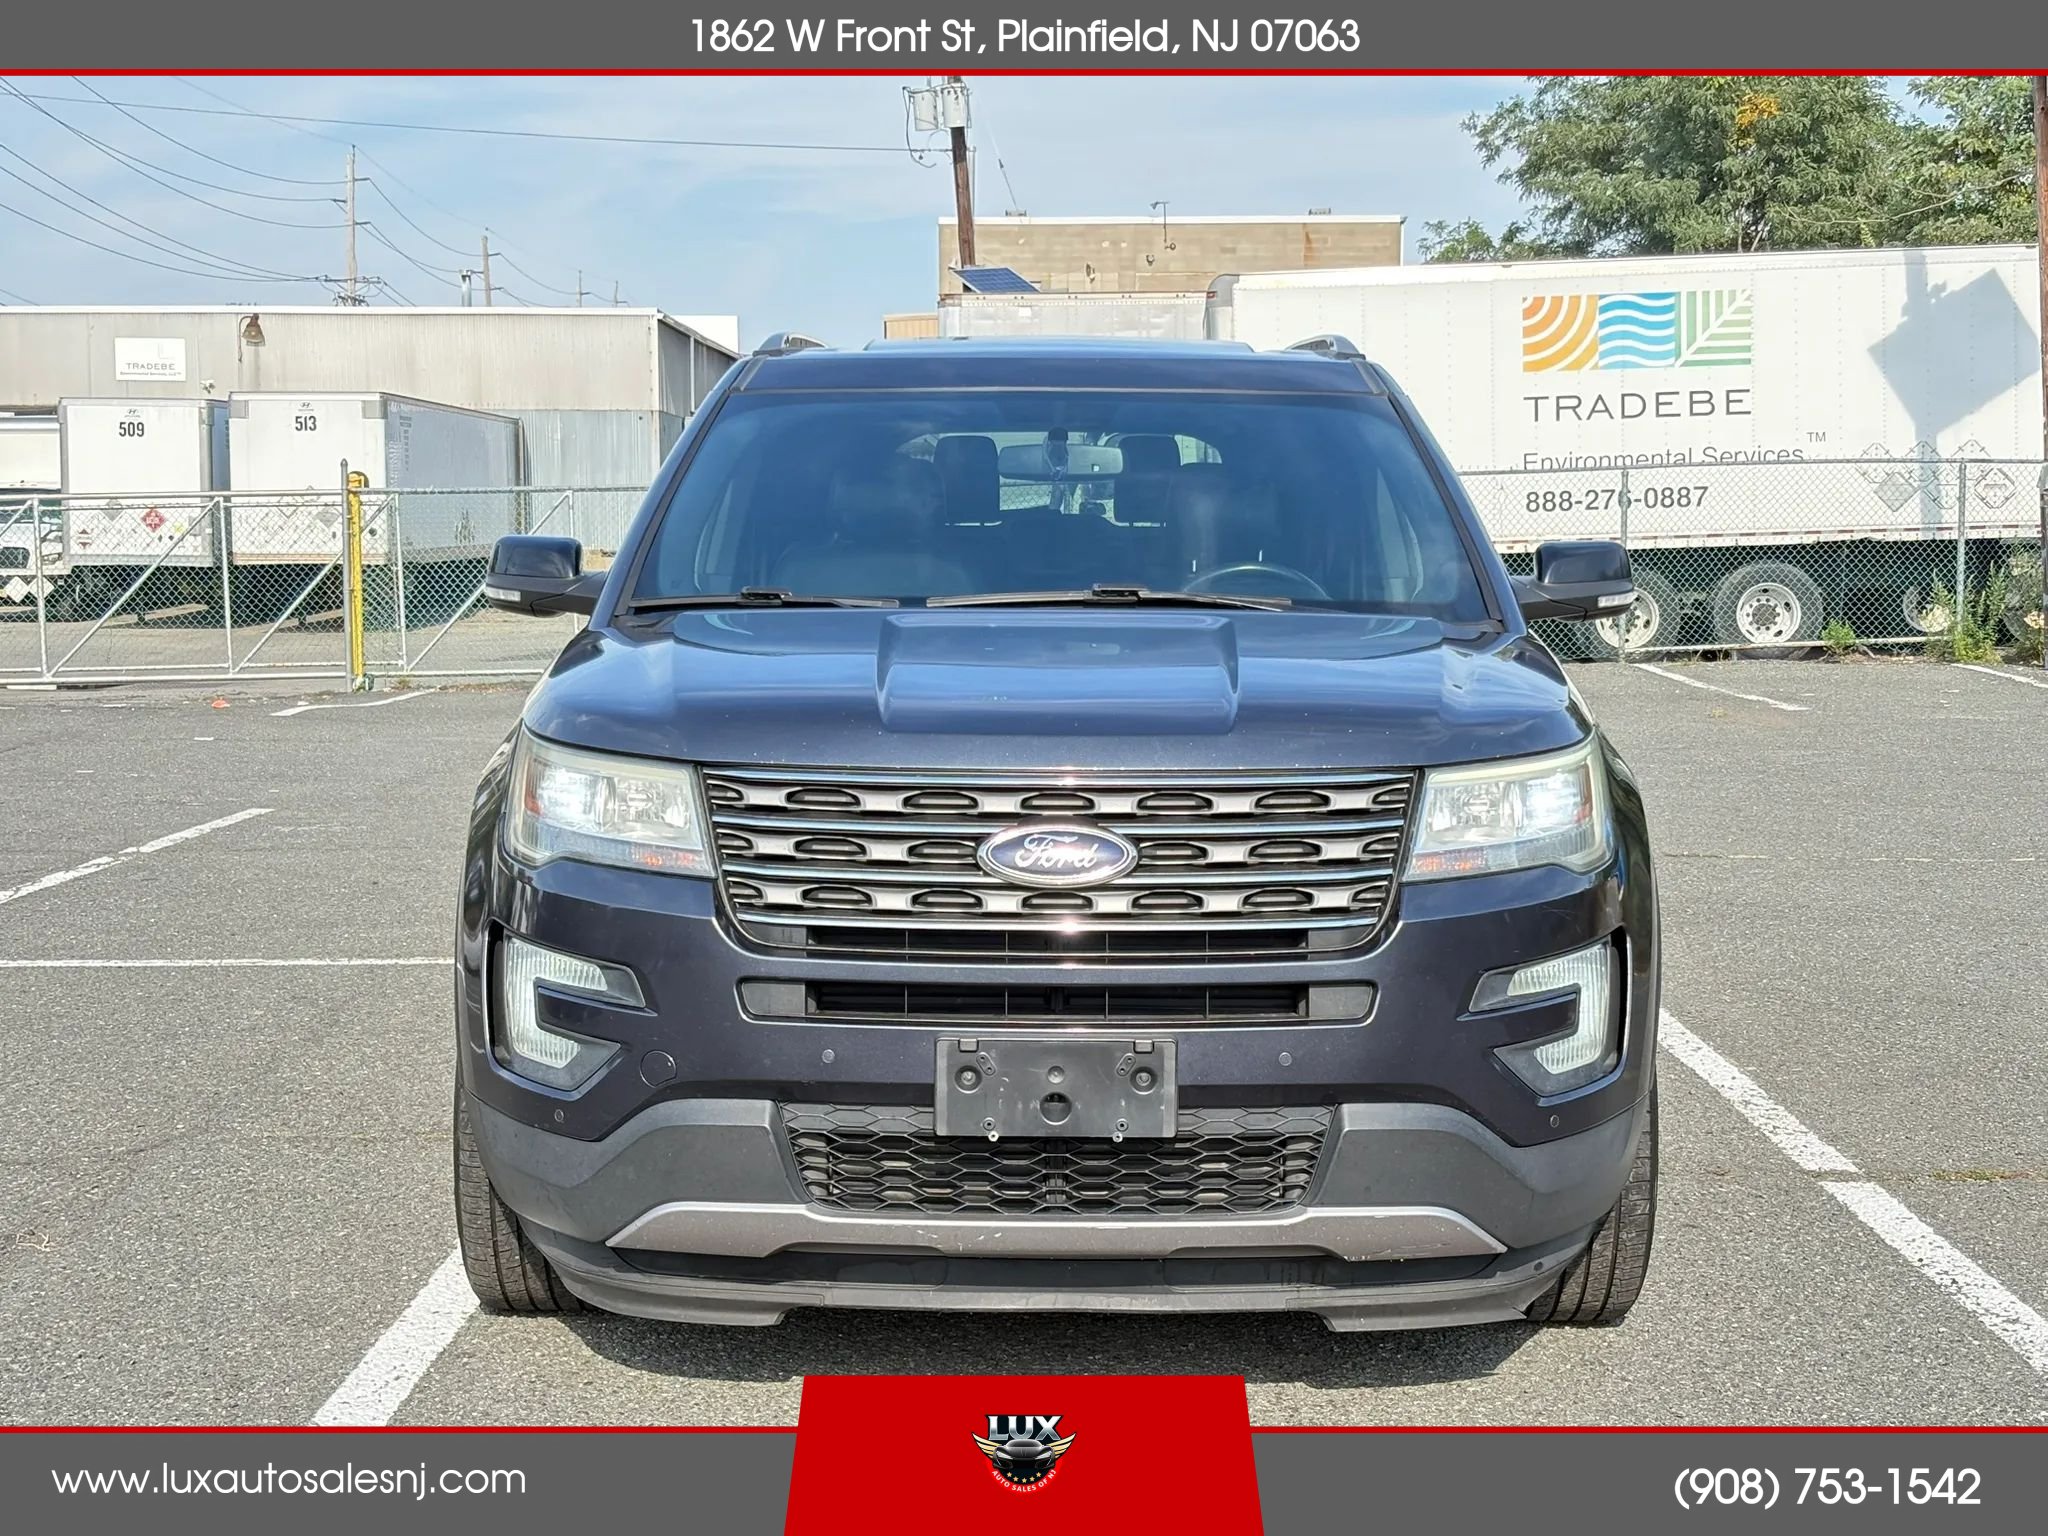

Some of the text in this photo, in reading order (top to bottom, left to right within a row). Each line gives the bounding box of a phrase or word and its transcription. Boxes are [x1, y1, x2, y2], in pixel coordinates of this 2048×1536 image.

[125, 362, 176, 371] TRADEBE
[1523, 389, 1752, 422] TRADEBE
[118, 421, 145, 437] 509
[295, 415, 317, 431] 513
[1523, 447, 1692, 470] Environmental
[1702, 445, 1804, 464] Services
[1014, 834, 1099, 868] Ford
